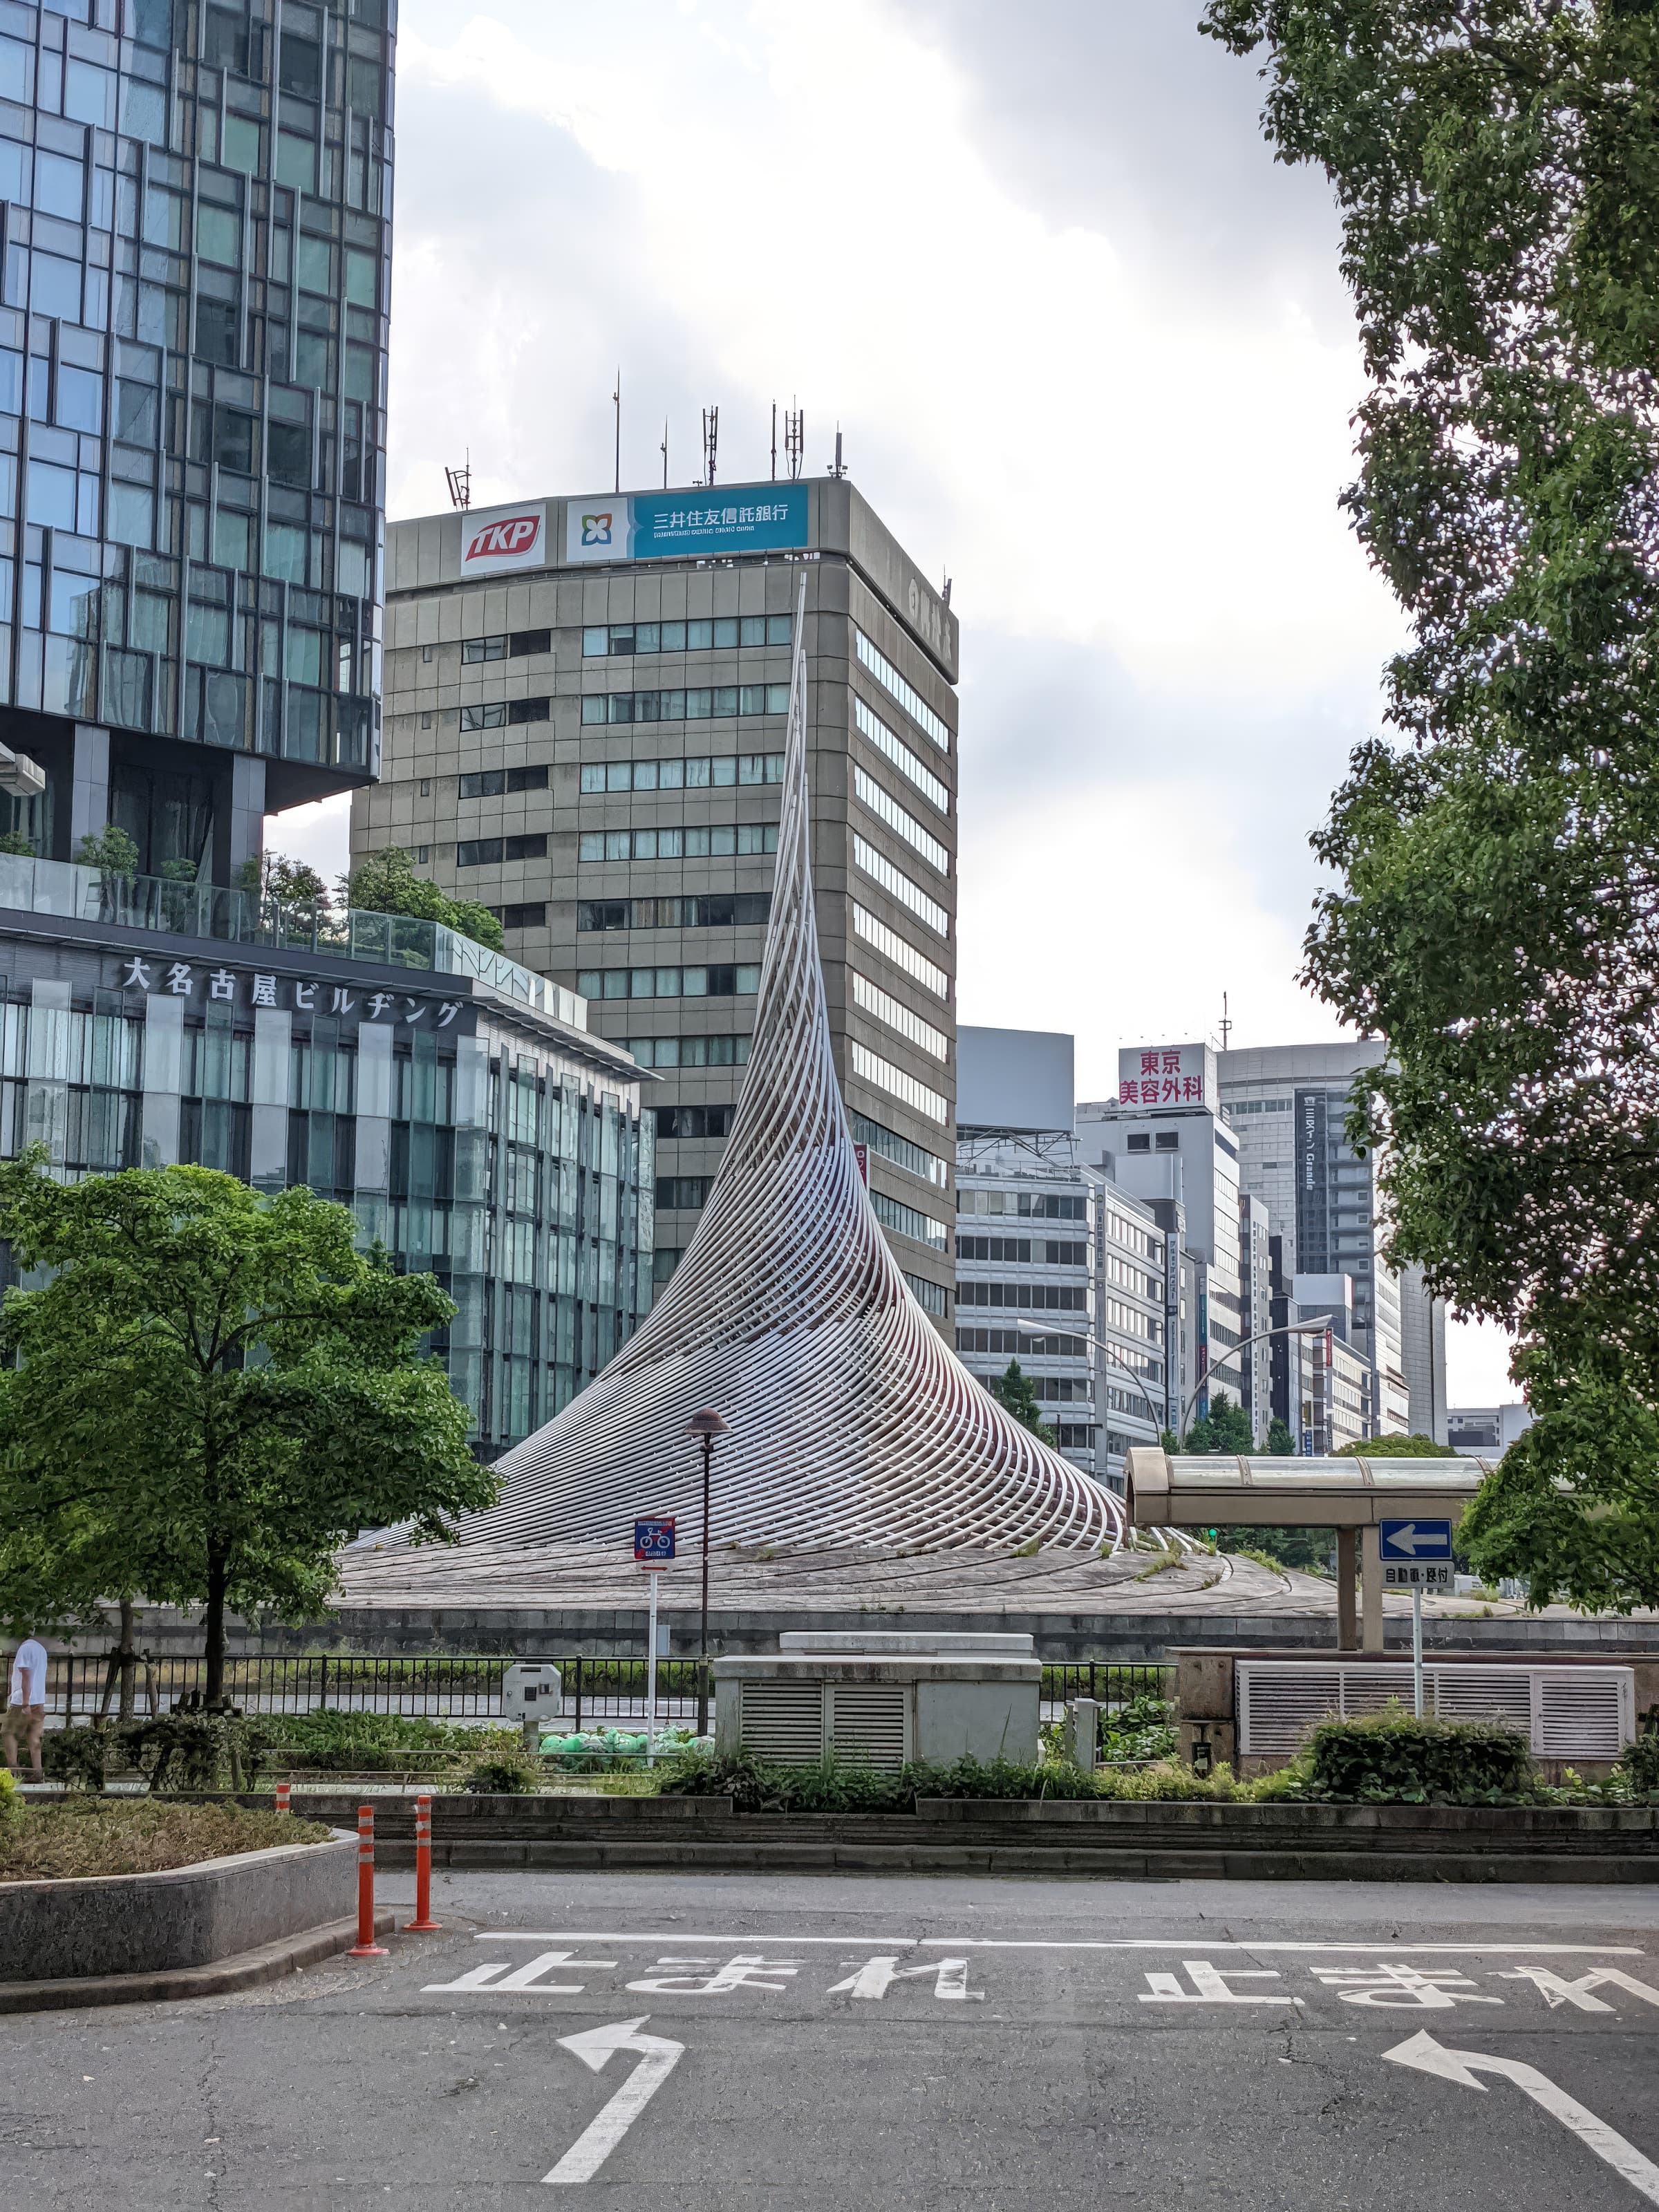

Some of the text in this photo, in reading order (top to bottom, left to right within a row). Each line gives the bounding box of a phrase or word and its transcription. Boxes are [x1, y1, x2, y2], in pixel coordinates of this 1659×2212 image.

[474, 521, 534, 554] TKP
[122, 956, 465, 1028] 大名古屋ビルヂング
[1140, 1049, 1181, 1076] 東京
[1119, 1075, 1203, 1105] 美容外科
[1386, 1567, 1448, 1583] 自・付
[419, 1951, 986, 2000] 止まれ
